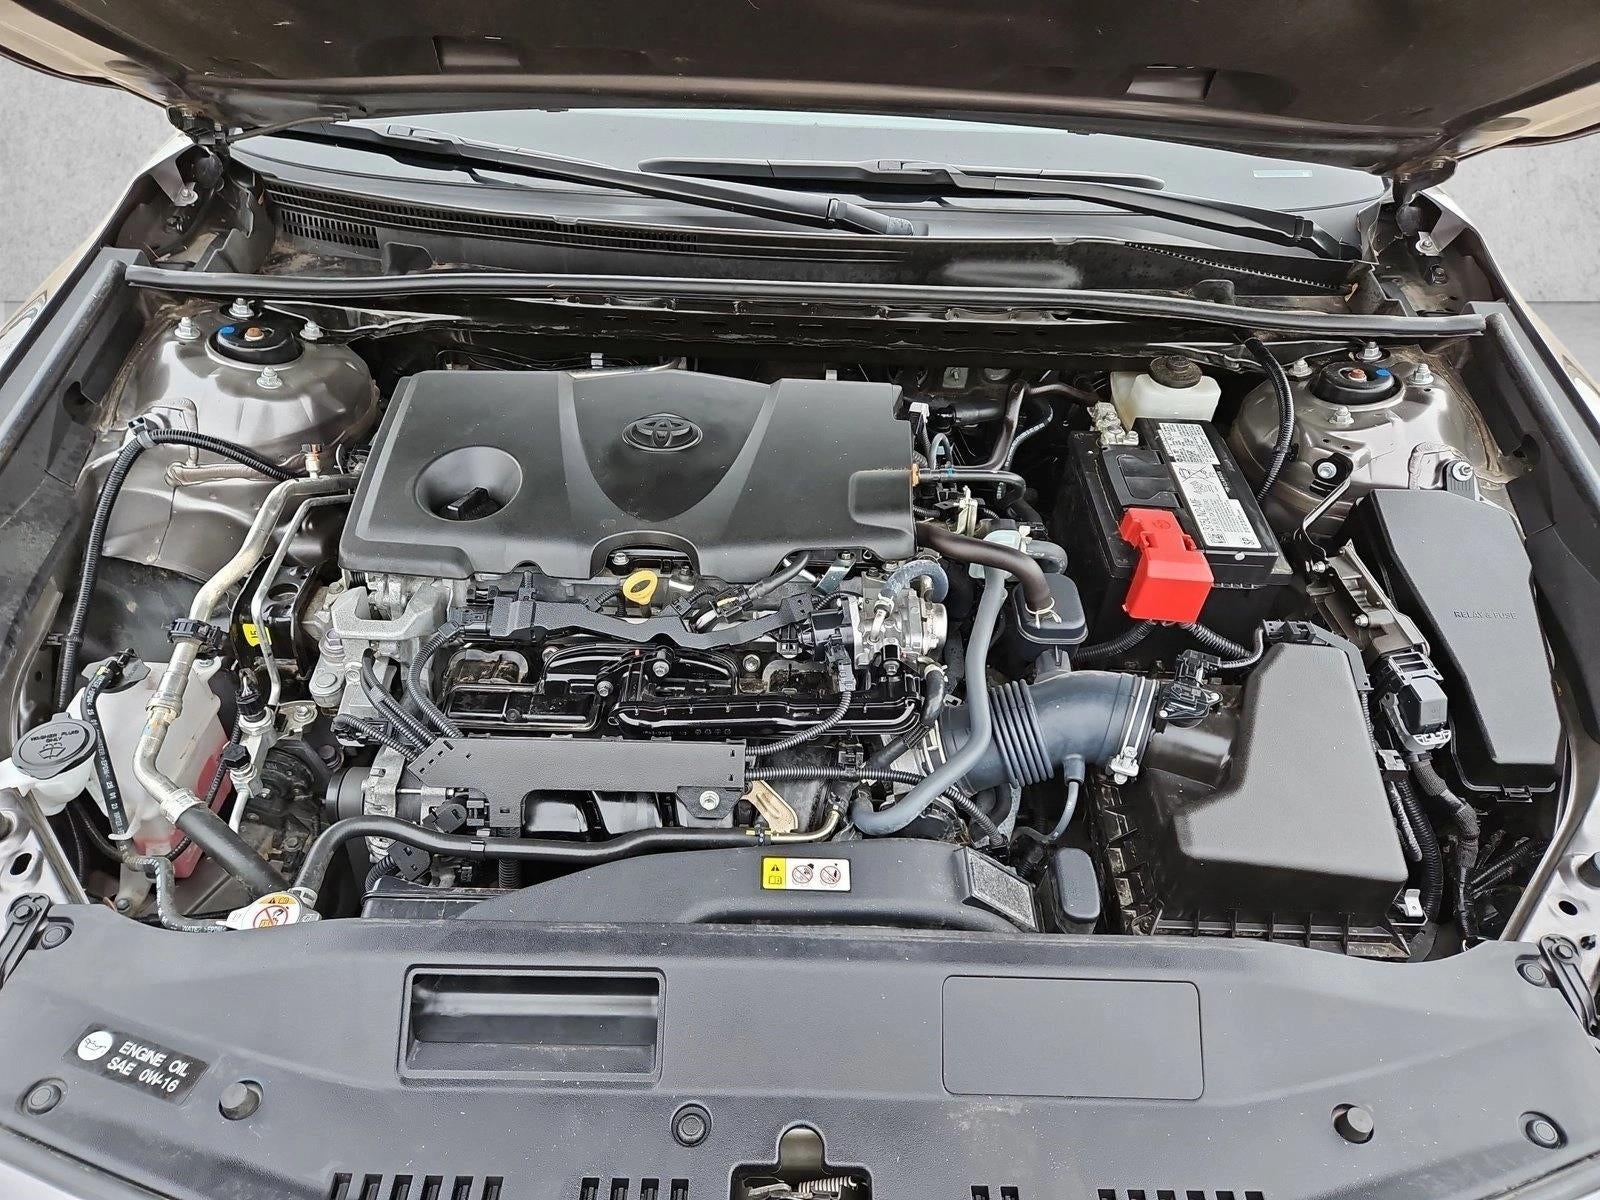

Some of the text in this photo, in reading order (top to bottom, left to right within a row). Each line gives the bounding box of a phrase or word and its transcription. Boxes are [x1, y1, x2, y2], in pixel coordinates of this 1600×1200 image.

[1453, 610, 1482, 619] RELAY
[1492, 611, 1518, 620] FUSE
[30, 732, 58, 742] WASHER
[118, 1041, 191, 1078] ENGINE OIL
[106, 1056, 180, 1093] SAE 0W-16
